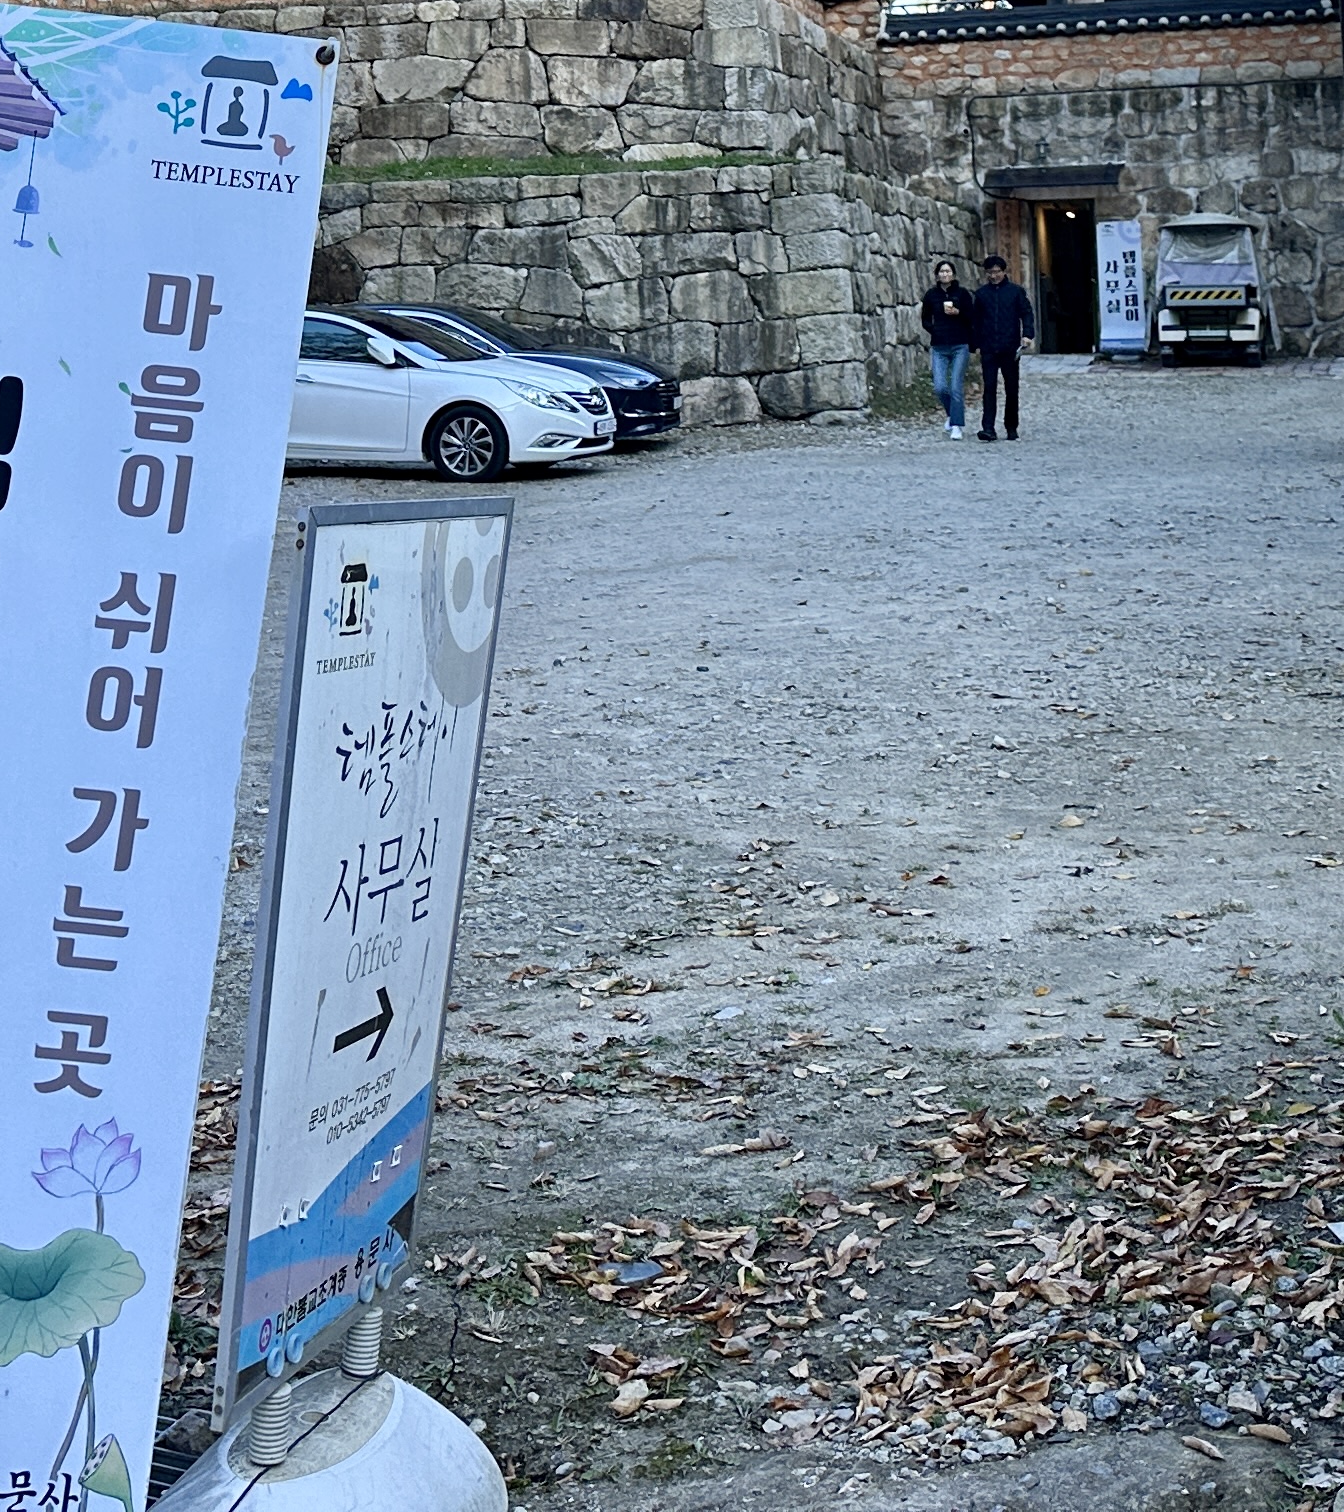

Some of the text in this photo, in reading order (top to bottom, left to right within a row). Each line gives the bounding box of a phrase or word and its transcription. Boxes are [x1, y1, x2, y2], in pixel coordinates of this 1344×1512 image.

[151, 159, 301, 194] TEMPLESTAY
[34, 272, 223, 1098] 마음이 쉬어 가는 곳
[317, 652, 376, 675] TEMPLESTAY
[335, 691, 459, 819] 템플스테이
[323, 817, 439, 936] 사무실
[346, 934, 403, 984] Office
[308, 1067, 396, 1133] 문의 031-775-5797
[354, 1225, 396, 1280] 용문사
